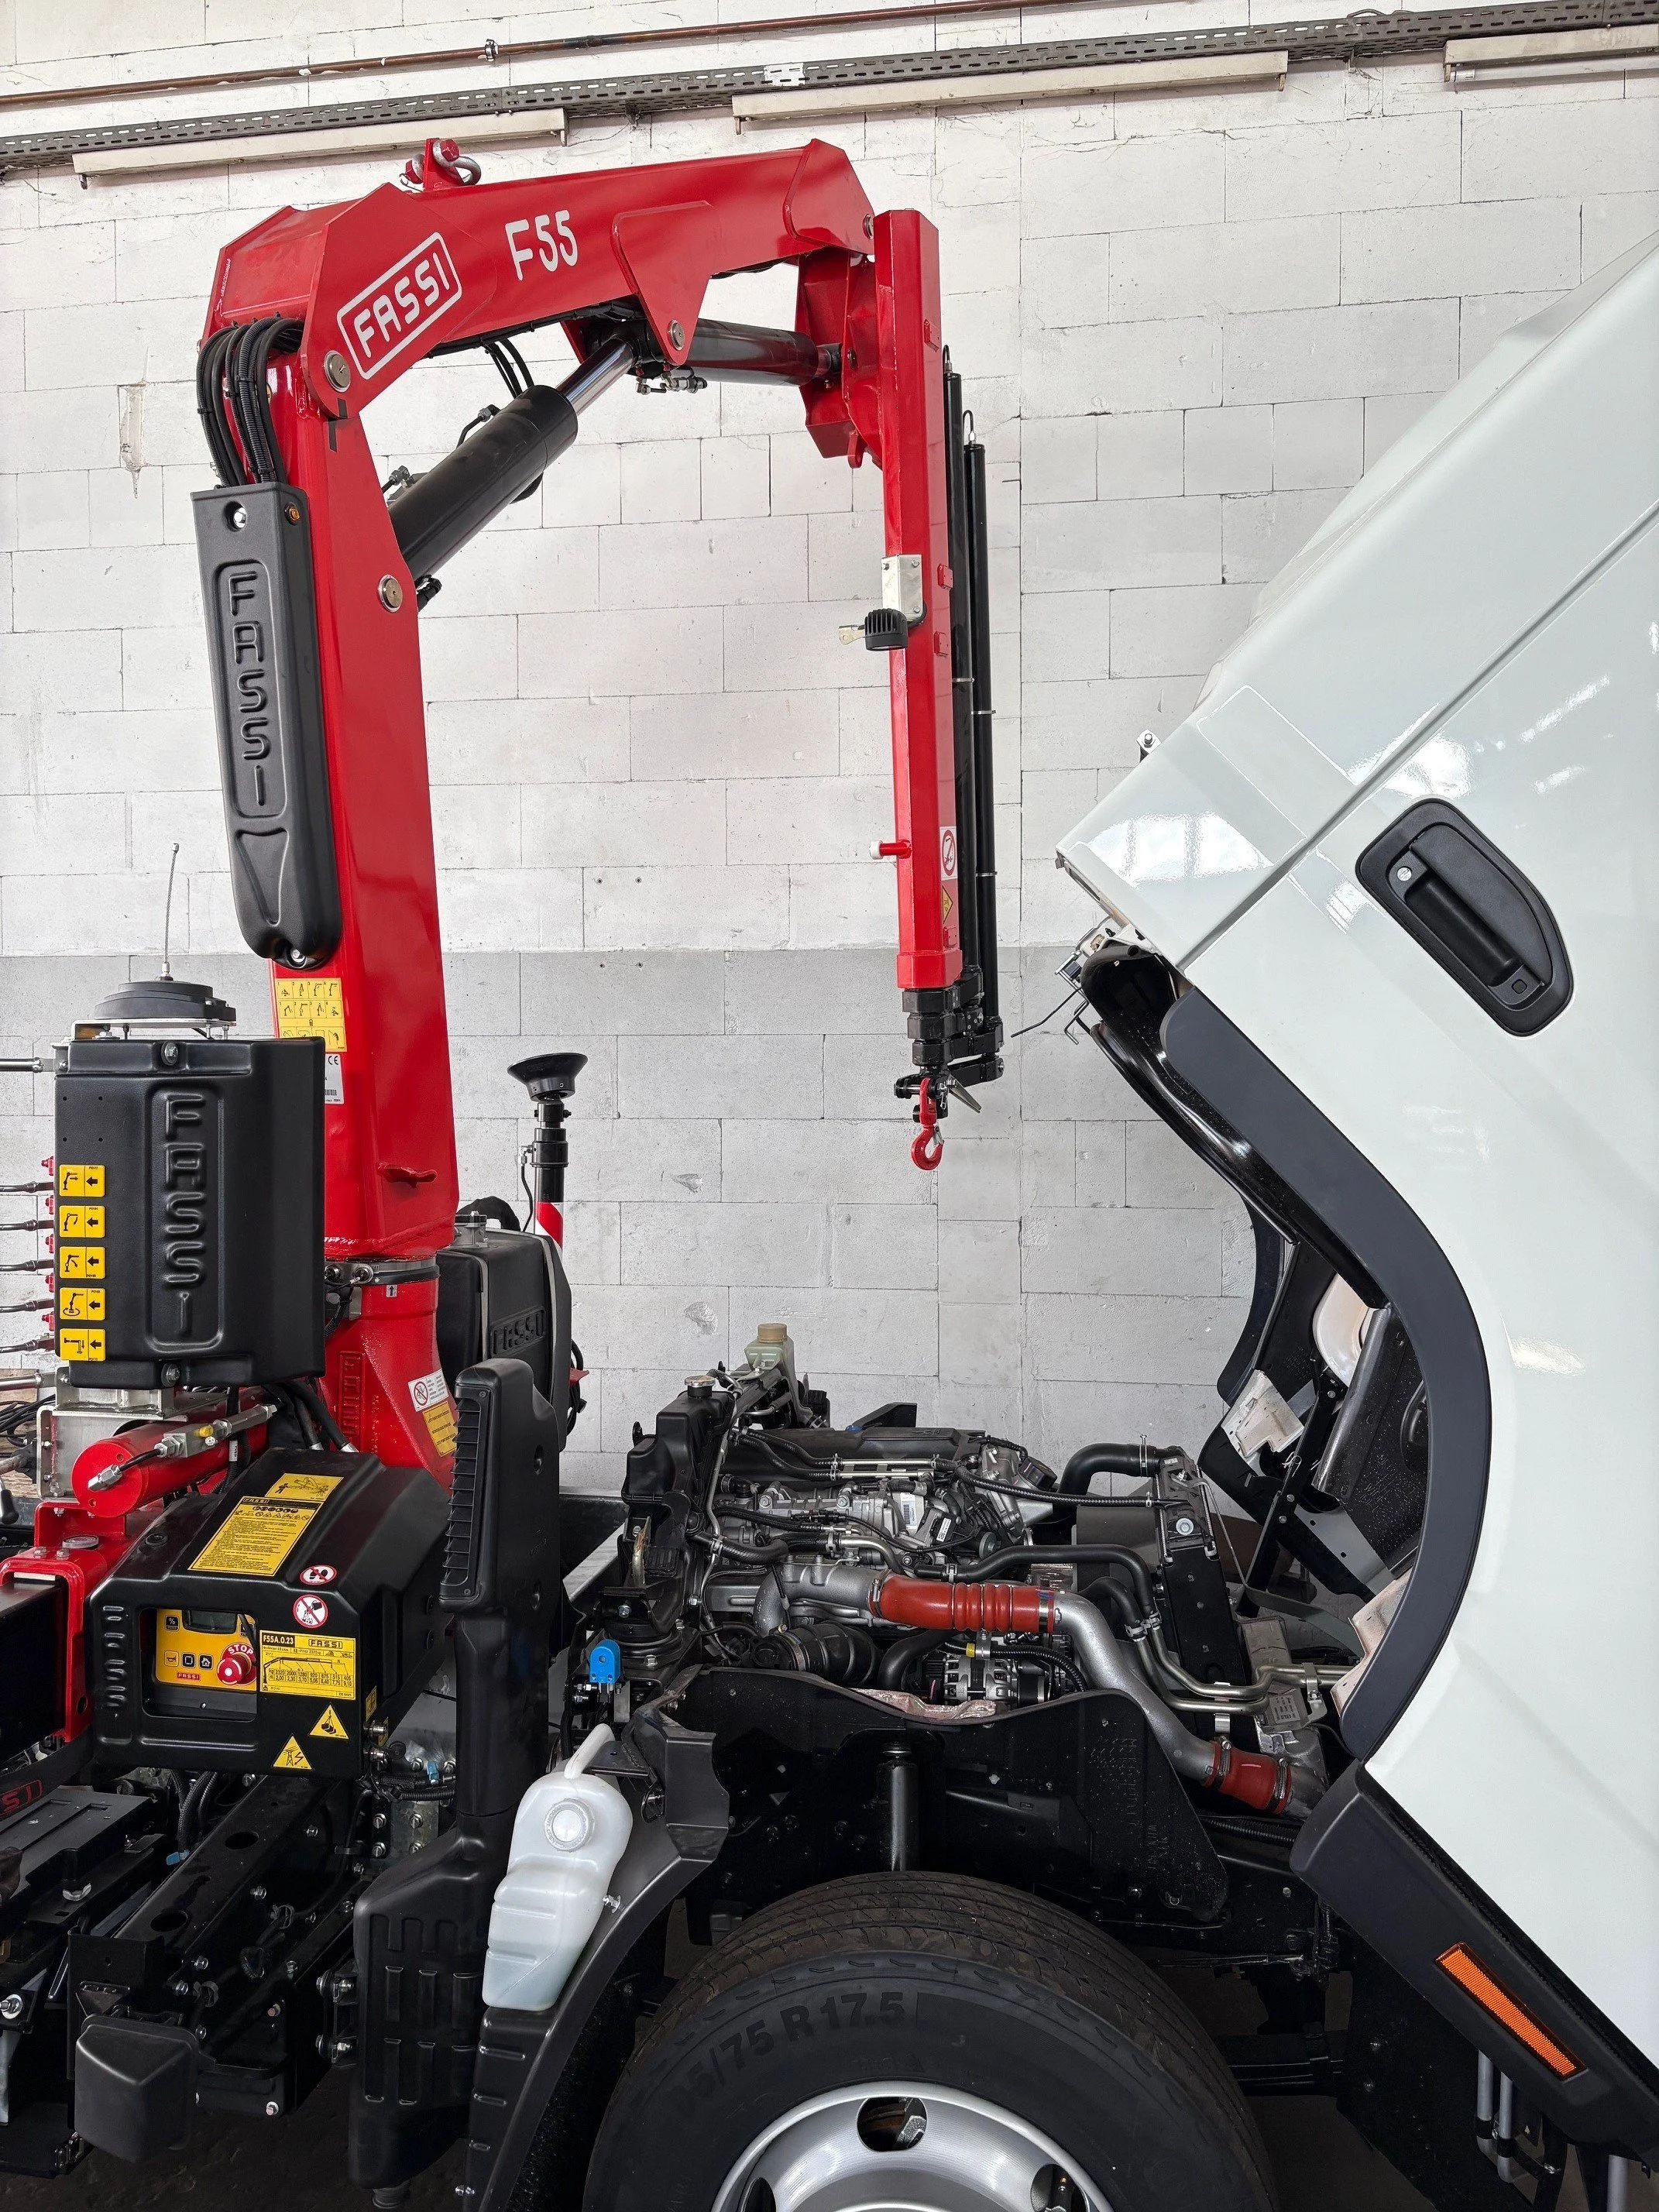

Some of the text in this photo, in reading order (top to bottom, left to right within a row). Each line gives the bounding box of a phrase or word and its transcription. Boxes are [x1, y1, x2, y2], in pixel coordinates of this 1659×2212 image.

[504, 209, 579, 281] F55
[353, 252, 450, 359] FASSI
[229, 569, 270, 807] FASSI
[328, 1055, 339, 1066] CE
[164, 1093, 205, 1337] FASSI
[228, 1644, 254, 1654] STOP
[263, 1634, 342, 1649] F55A.0.23 FASSI
[779, 2004, 813, 2042] R
[819, 1991, 905, 2032] 17.5
